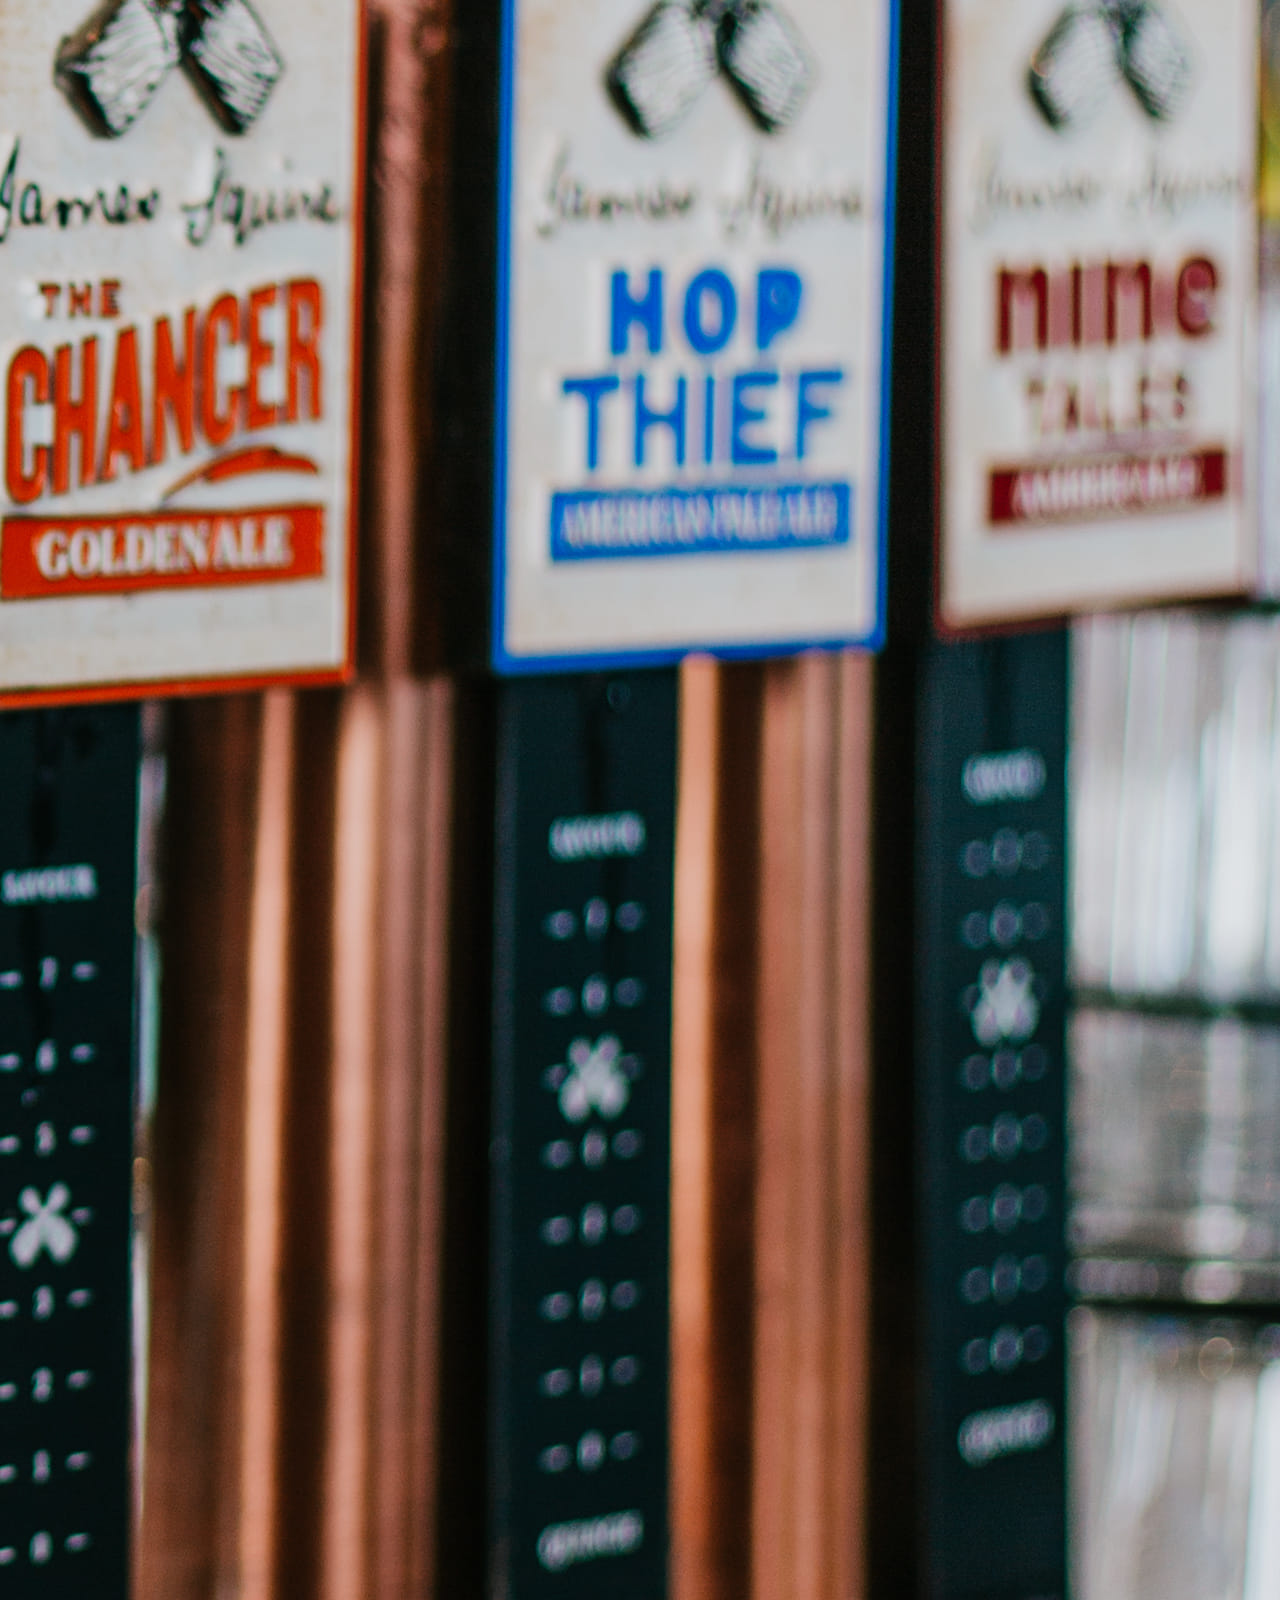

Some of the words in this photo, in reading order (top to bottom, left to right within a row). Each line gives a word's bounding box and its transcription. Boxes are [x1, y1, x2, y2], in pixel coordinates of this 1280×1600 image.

[39, 279, 122, 319] THE
[608, 266, 804, 357] HOP
[4, 276, 325, 506] CHANCER
[560, 369, 846, 472] THIEF
[34, 518, 210, 582] GOLDEN
[213, 514, 294, 573] ALE
